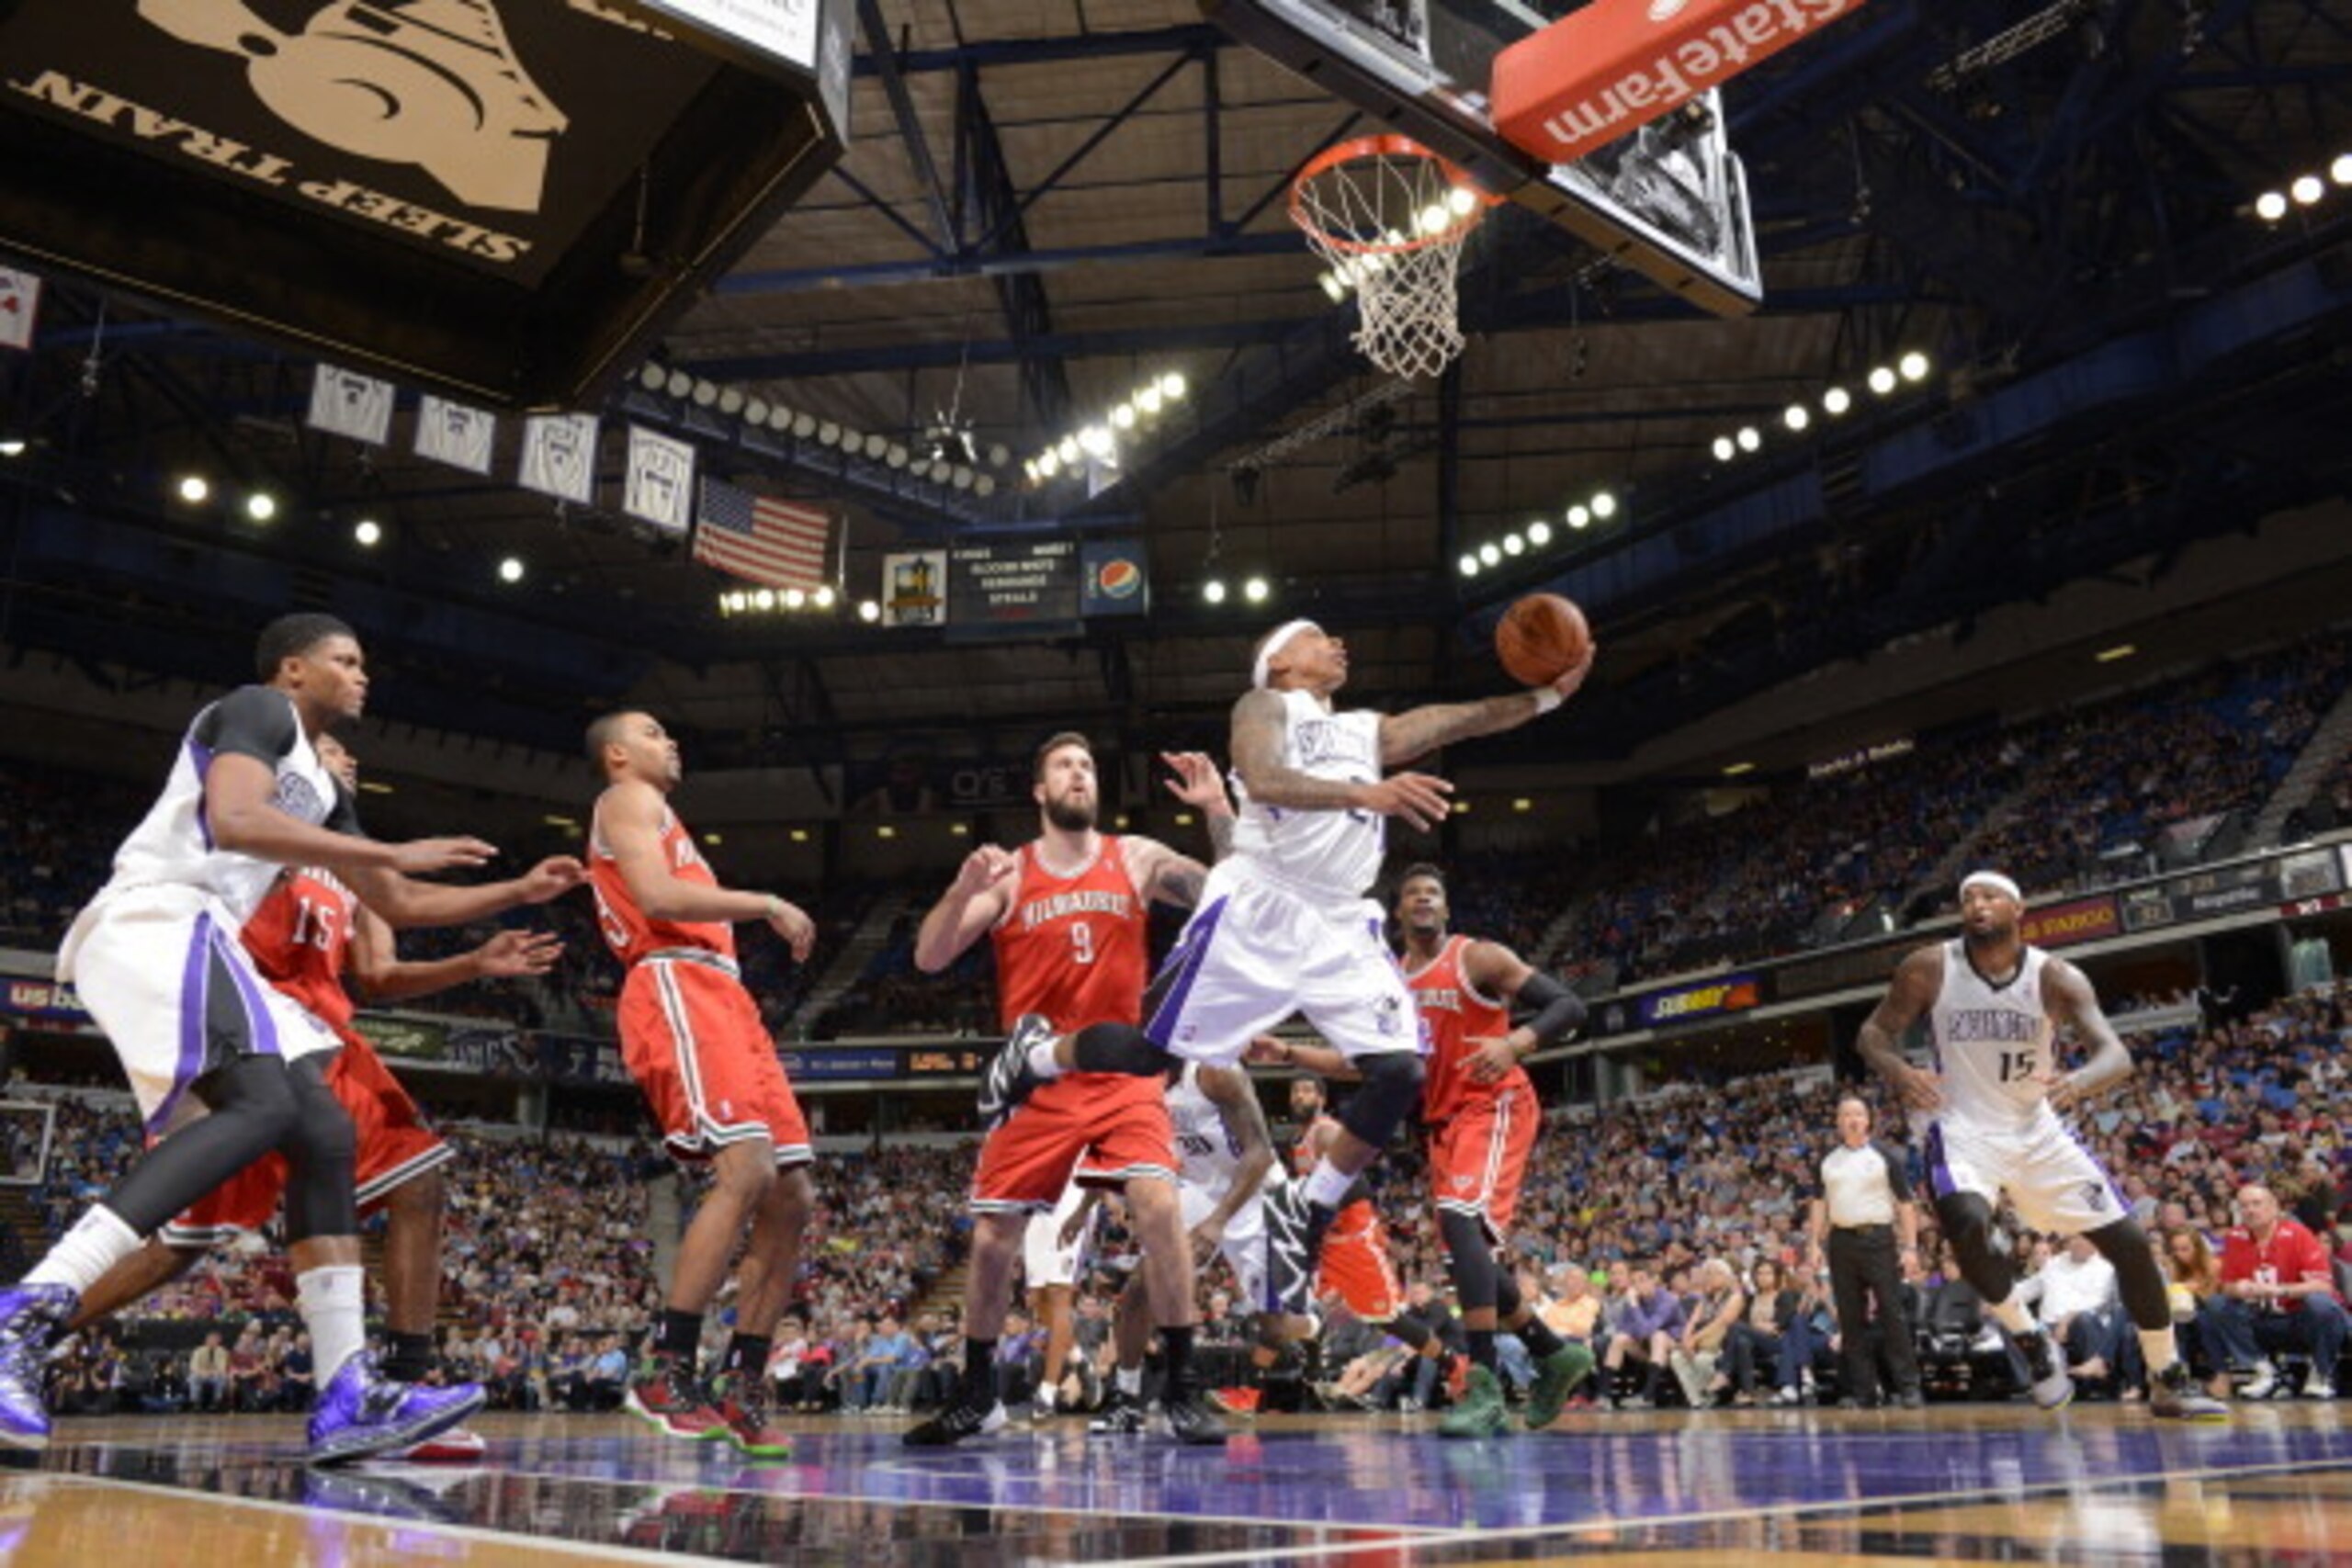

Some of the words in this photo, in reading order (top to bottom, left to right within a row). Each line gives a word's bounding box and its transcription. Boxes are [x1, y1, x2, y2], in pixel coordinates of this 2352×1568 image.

[20, 70, 294, 185] TRAIN
[298, 180, 532, 262] SLEEP
[291, 897, 337, 952] 15
[1070, 921, 1094, 964] 9
[1652, 985, 1731, 1019] SUBWAY
[1999, 1048, 2036, 1082] 15
